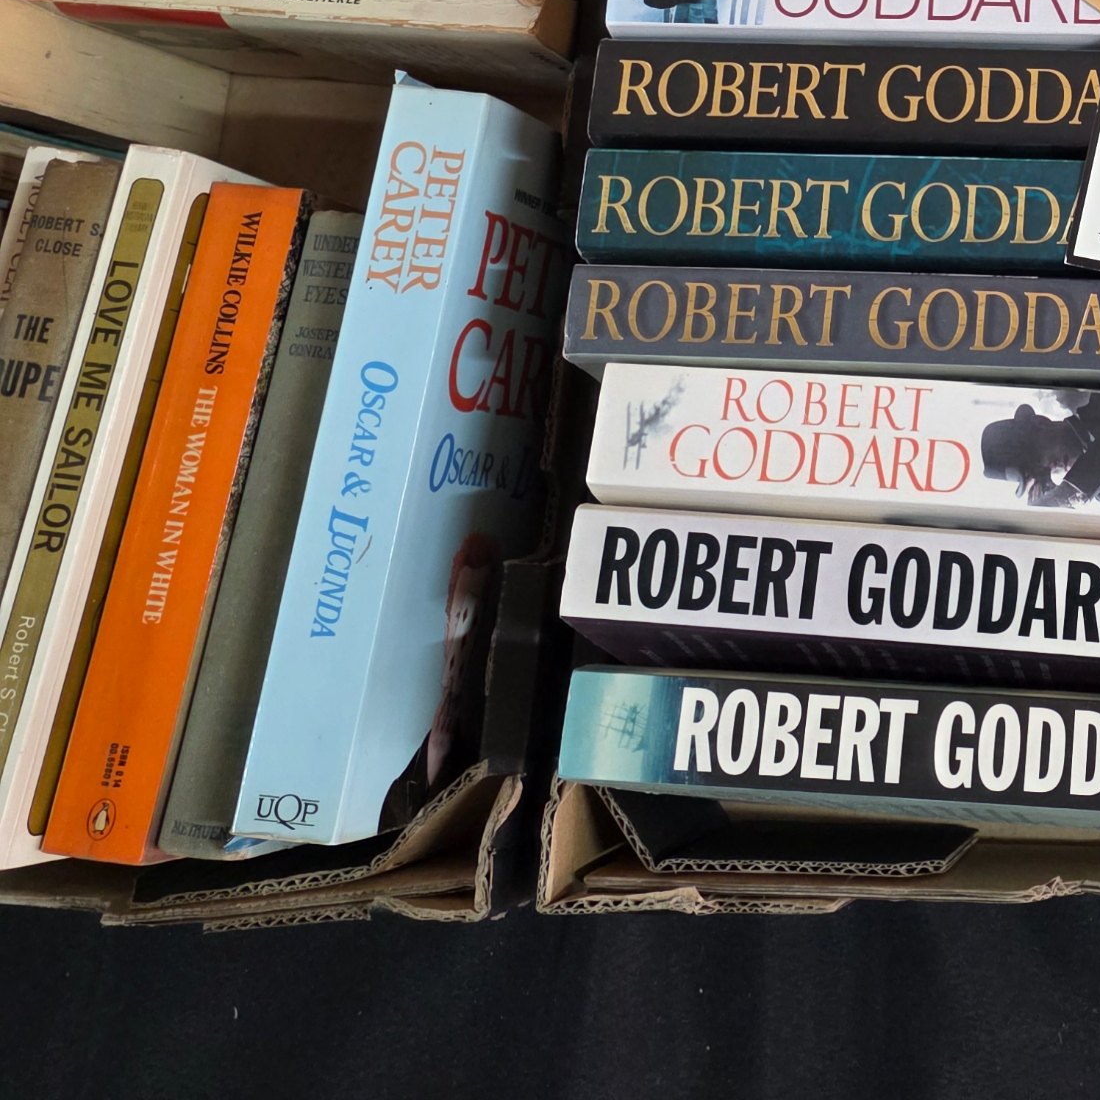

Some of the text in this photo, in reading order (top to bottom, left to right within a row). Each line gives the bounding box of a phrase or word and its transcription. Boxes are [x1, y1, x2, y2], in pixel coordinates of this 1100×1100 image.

[364, 140, 427, 294] CAREY
[401, 145, 467, 294] PETER
[90, 260, 139, 347] LOVE
[73, 361, 112, 412] ME
[142, 211, 263, 625] WILKIE COLLINS THE WOMAN IN WHITE
[720, 376, 934, 433] ROBERT
[34, 426, 93, 554] SAILOR
[309, 360, 399, 639] OSCAR & LUCINDA
[669, 424, 970, 493] GODDARD
[673, 686, 919, 784] ROBERT
[255, 793, 319, 831] UQP
